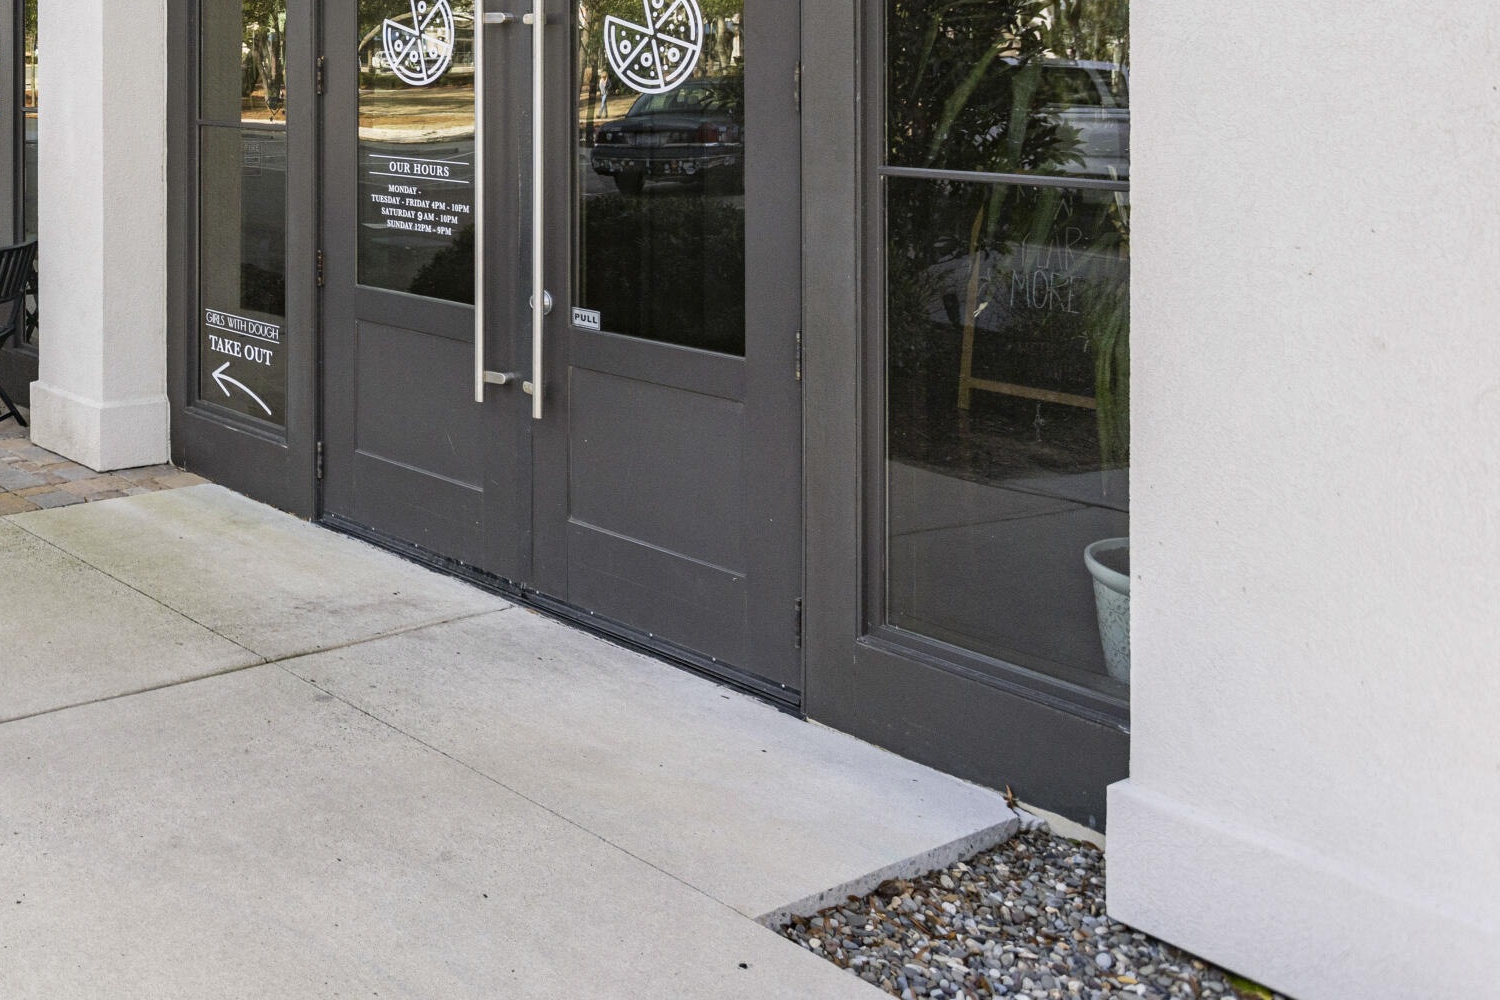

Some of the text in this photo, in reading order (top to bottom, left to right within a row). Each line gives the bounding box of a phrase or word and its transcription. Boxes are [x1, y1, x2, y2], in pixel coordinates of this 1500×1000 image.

[389, 161, 450, 177] OUR HOURS
[388, 184, 417, 195] MONDAY
[371, 194, 401, 205] TUESDAY
[405, 198, 430, 209] FRIDAY
[431, 200, 446, 211] 4PM
[451, 203, 470, 214] 10PM
[381, 207, 416, 219] SATURDAY
[440, 214, 458, 225] 10PM
[386, 219, 413, 230] SUNDAY
[414, 223, 432, 233] 12PM
[1010, 270, 1080, 314] MORE
[206, 311, 279, 340] GIRLS WITH DOUGH
[574, 313, 598, 324] PULL
[209, 334, 273, 366] TAKE OUT
